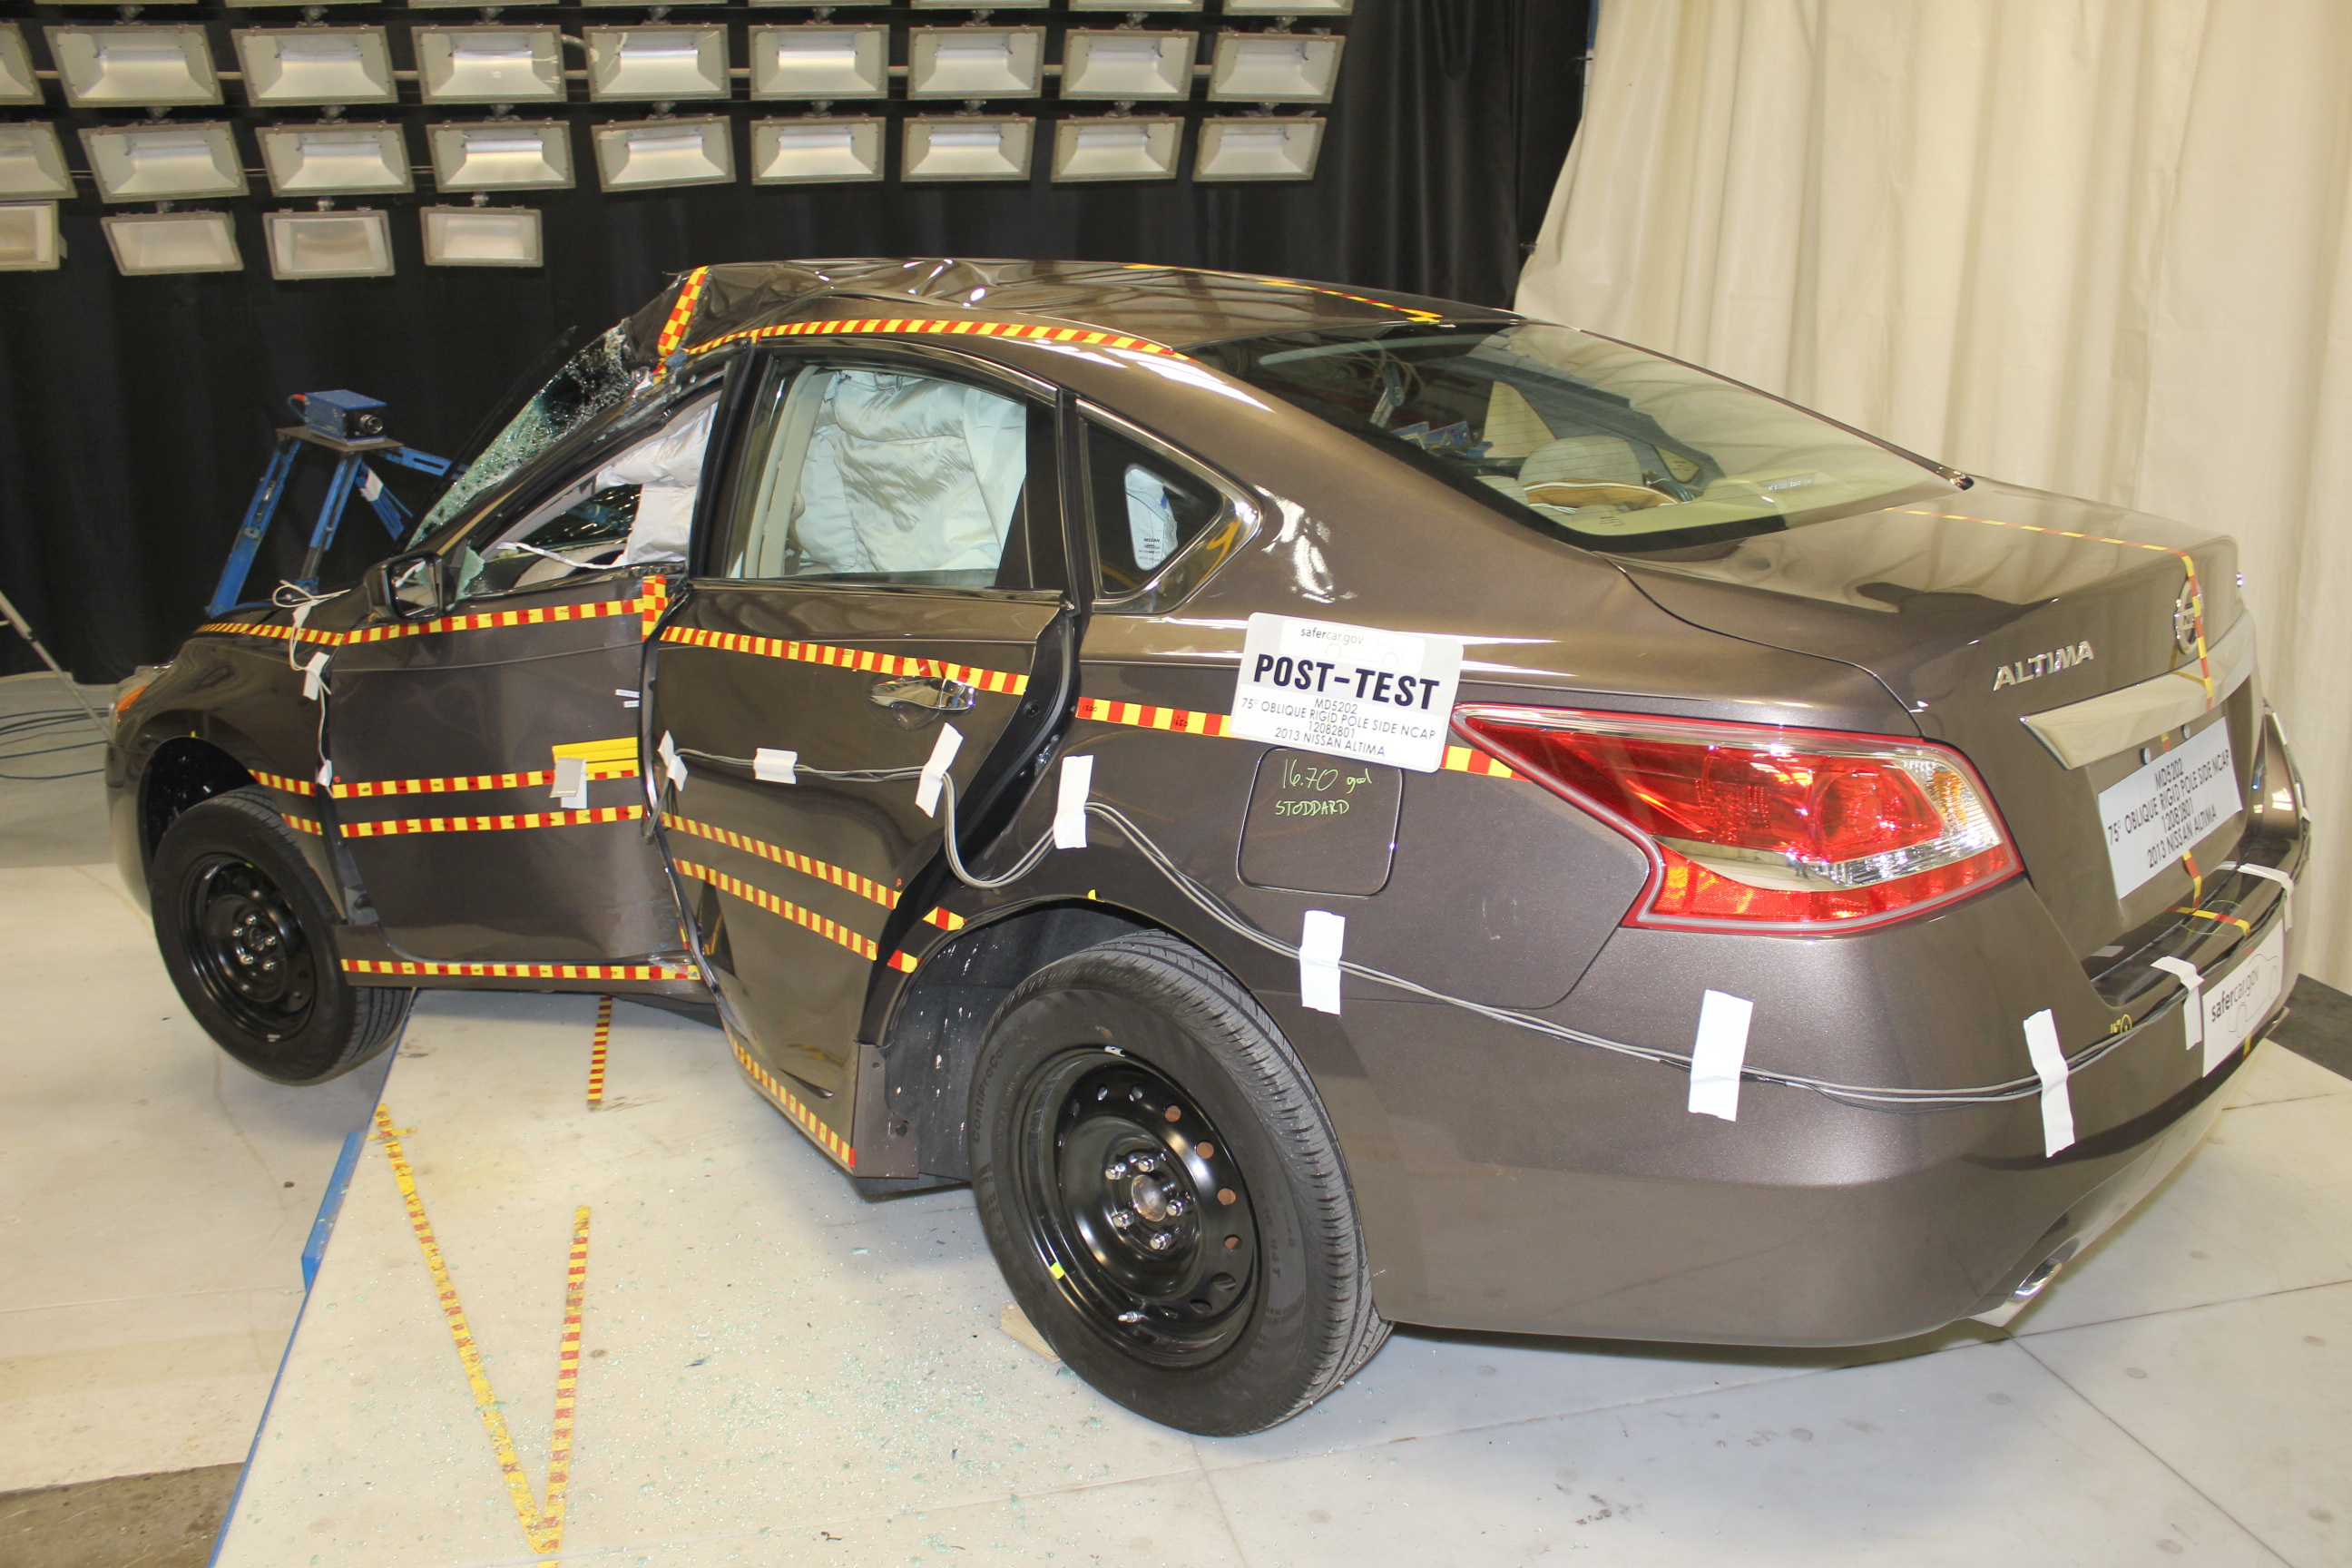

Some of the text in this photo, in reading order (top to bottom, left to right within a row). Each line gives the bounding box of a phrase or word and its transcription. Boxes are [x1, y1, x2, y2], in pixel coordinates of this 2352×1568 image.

[1300, 627, 1364, 645] safercar.gov
[1253, 653, 1440, 710] POST-TEST
[1992, 640, 2094, 691] ALTIMA
[1241, 698, 1436, 740] 75° OBLIQUE RIGID POLE SIDE NCAP
[1314, 698, 1358, 715] MD5202
[1274, 727, 1386, 757] 2013 NISSAN ALTIMA
[1308, 720, 1356, 739] 12082801
[1282, 759, 1372, 794] 16.70 gal
[2124, 797, 2159, 834] OBLIQUE
[2160, 783, 2180, 811] RIGID
[2180, 770, 2199, 798] POLE
[2197, 760, 2212, 786] SIDE
[2211, 749, 2230, 775] NCAP
[2154, 758, 2183, 791] MD5202
[1275, 799, 1350, 817] STODDARD
[2161, 796, 2194, 833] 12082801
[2147, 803, 2218, 868] 2013 NISSAN ALTIMA
